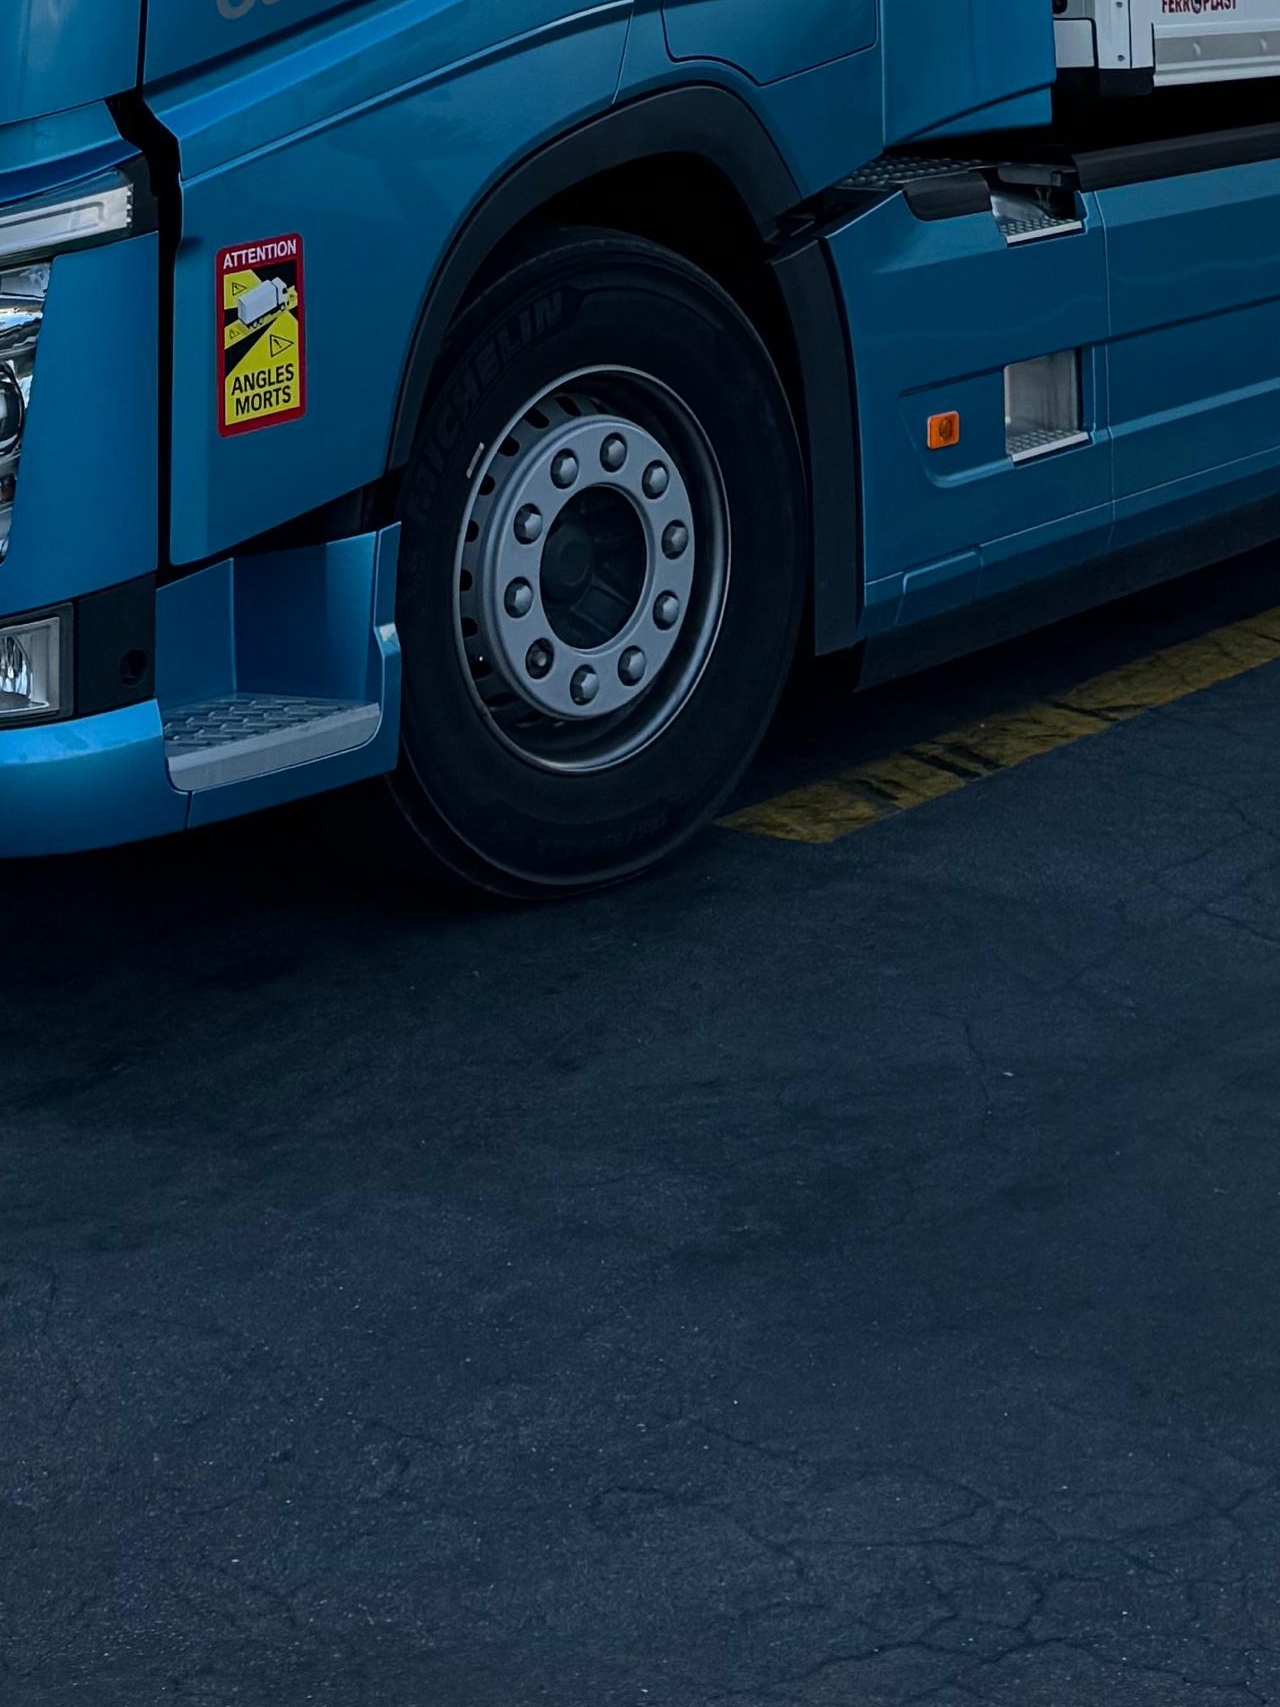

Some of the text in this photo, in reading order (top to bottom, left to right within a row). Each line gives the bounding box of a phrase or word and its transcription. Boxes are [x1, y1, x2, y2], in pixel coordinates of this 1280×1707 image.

[223, 239, 297, 270] ATTENTION
[231, 363, 295, 396] ANGLES
[235, 385, 292, 417] MORTS
